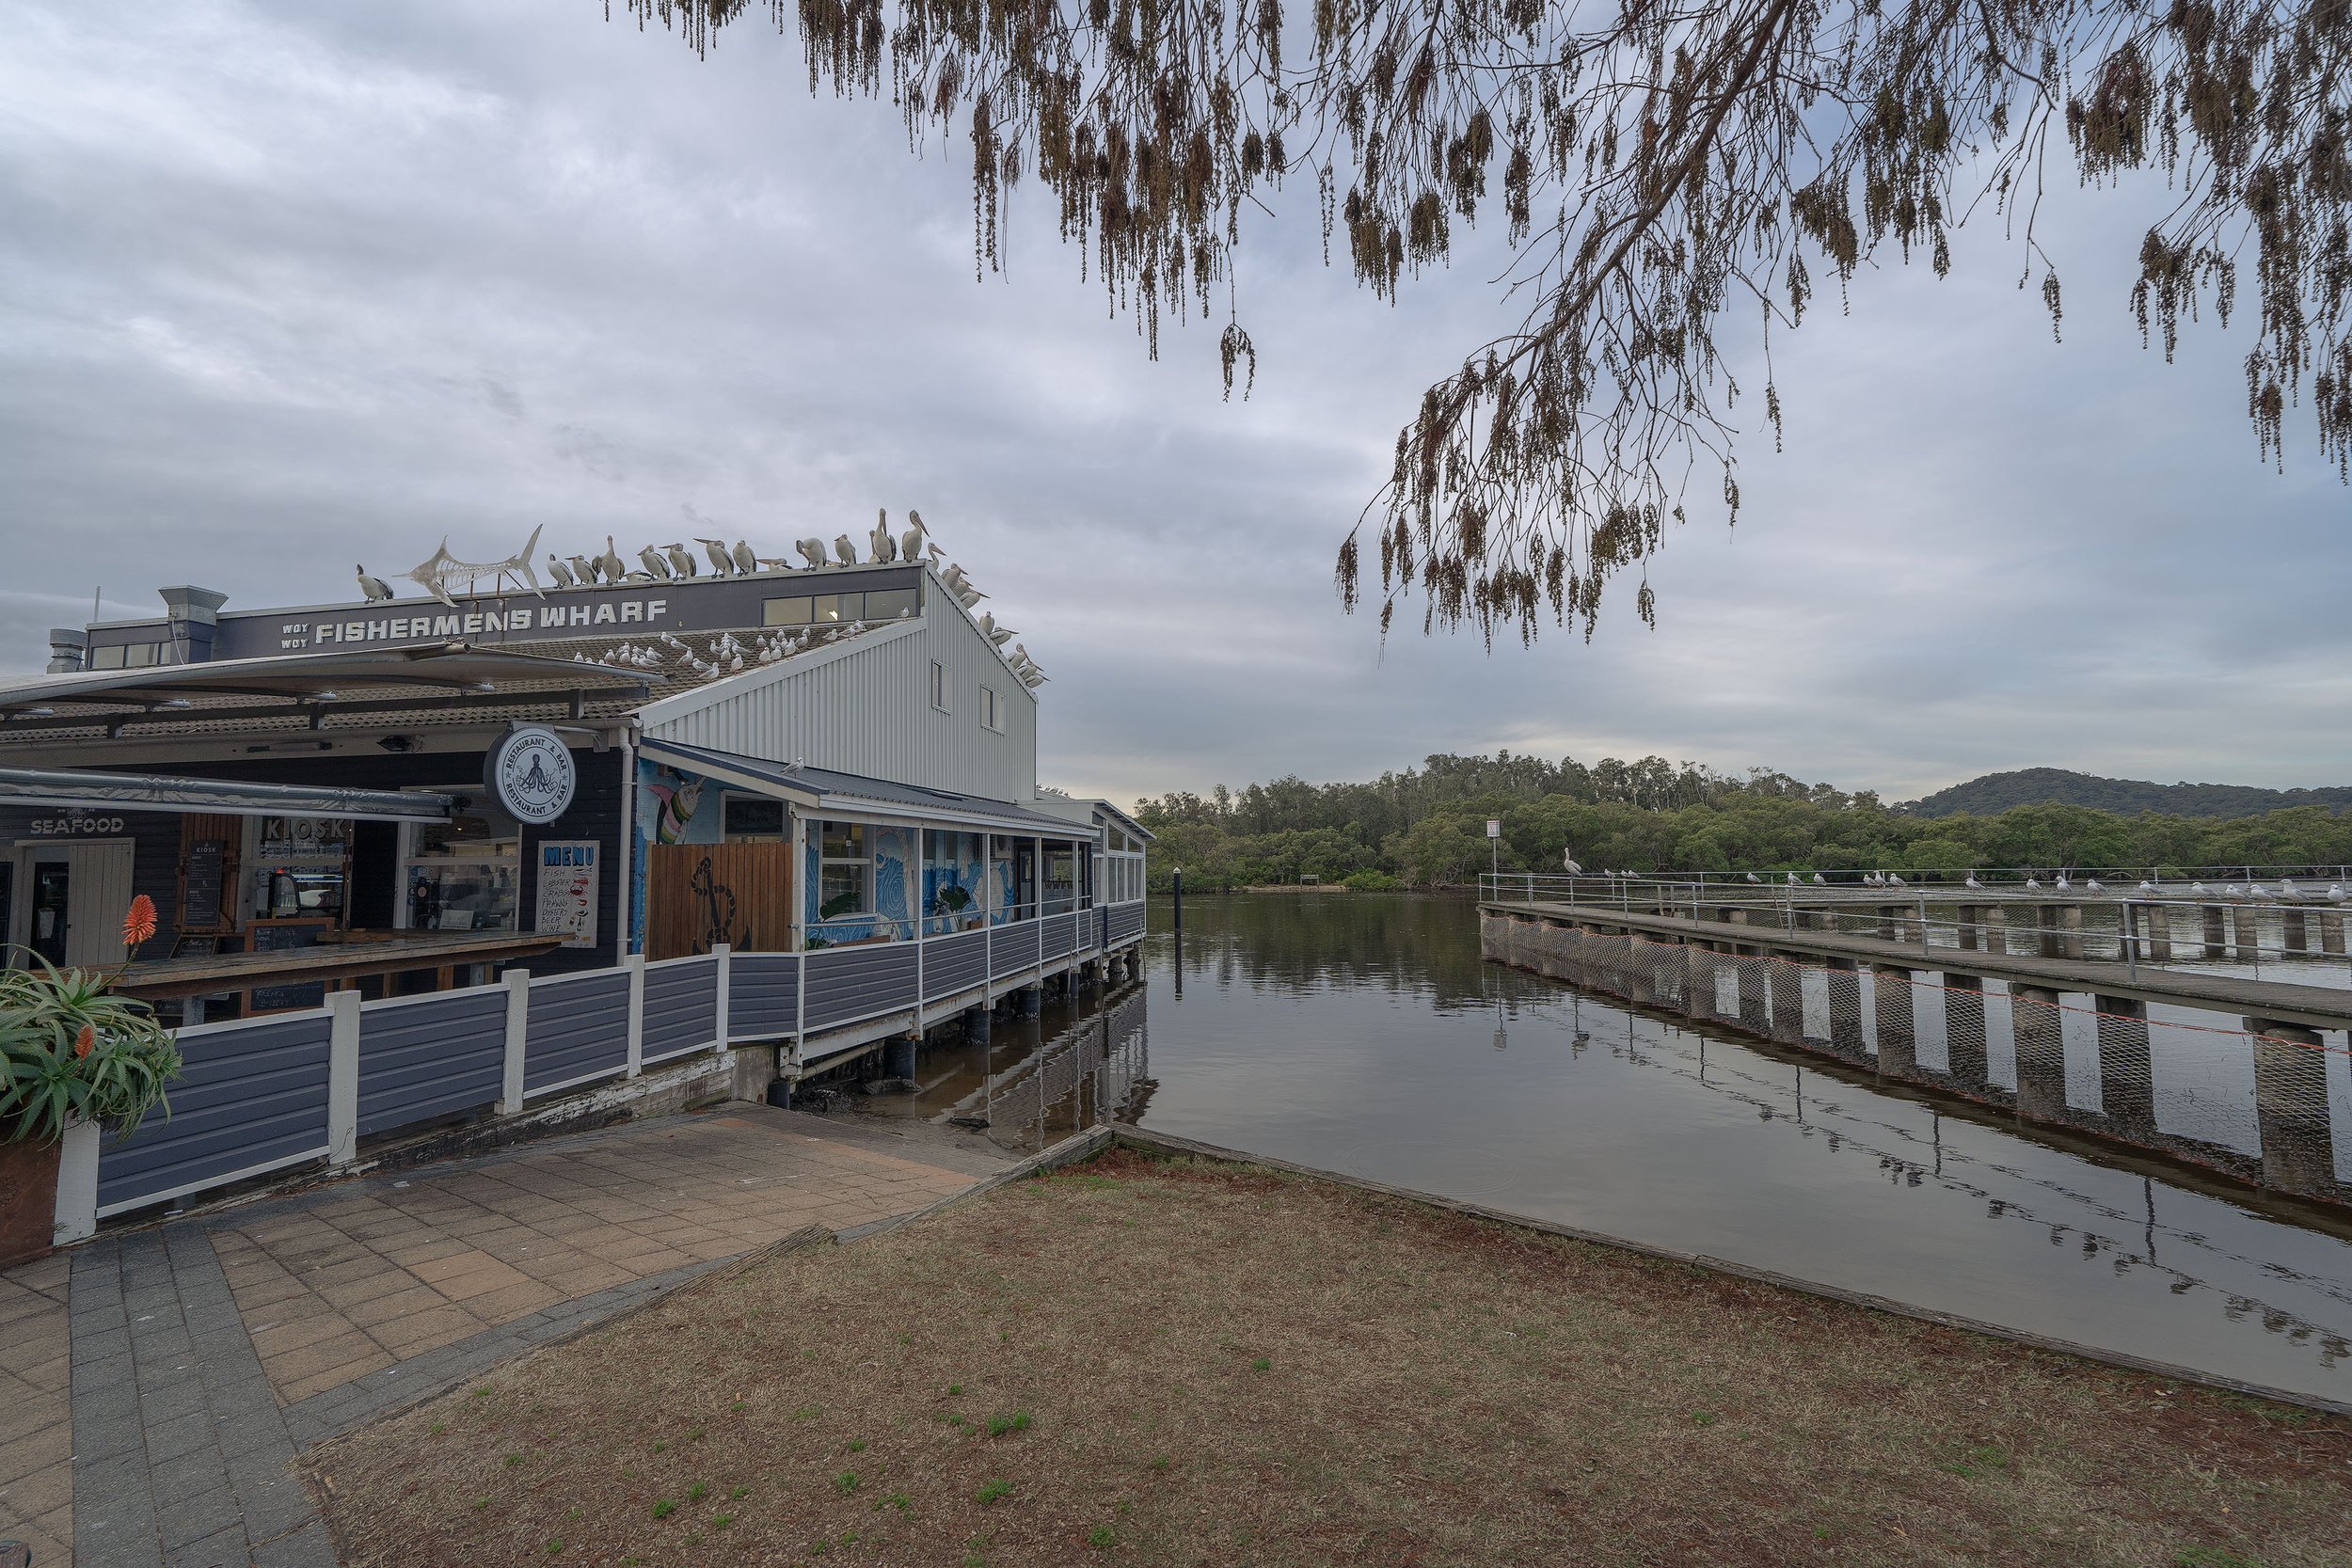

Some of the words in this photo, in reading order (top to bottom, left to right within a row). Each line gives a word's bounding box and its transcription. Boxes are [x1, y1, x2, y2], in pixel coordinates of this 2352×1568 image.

[282, 623, 309, 634] WOY
[315, 609, 532, 644] FISHERMENS
[540, 600, 667, 628] WHARF
[281, 638, 308, 649] WOY
[506, 738, 546, 769] RESTAURANT
[557, 753, 567, 770] BAR
[506, 783, 547, 815] RESTAURANT
[557, 784, 567, 801] BAR
[30, 817, 124, 834] SEAFOOD
[266, 818, 345, 840] KIOSK
[544, 846, 595, 867] MENU
[543, 889, 568, 898] CRABS
[542, 898, 568, 909] PRAWNS
[542, 916, 562, 925] BEER
